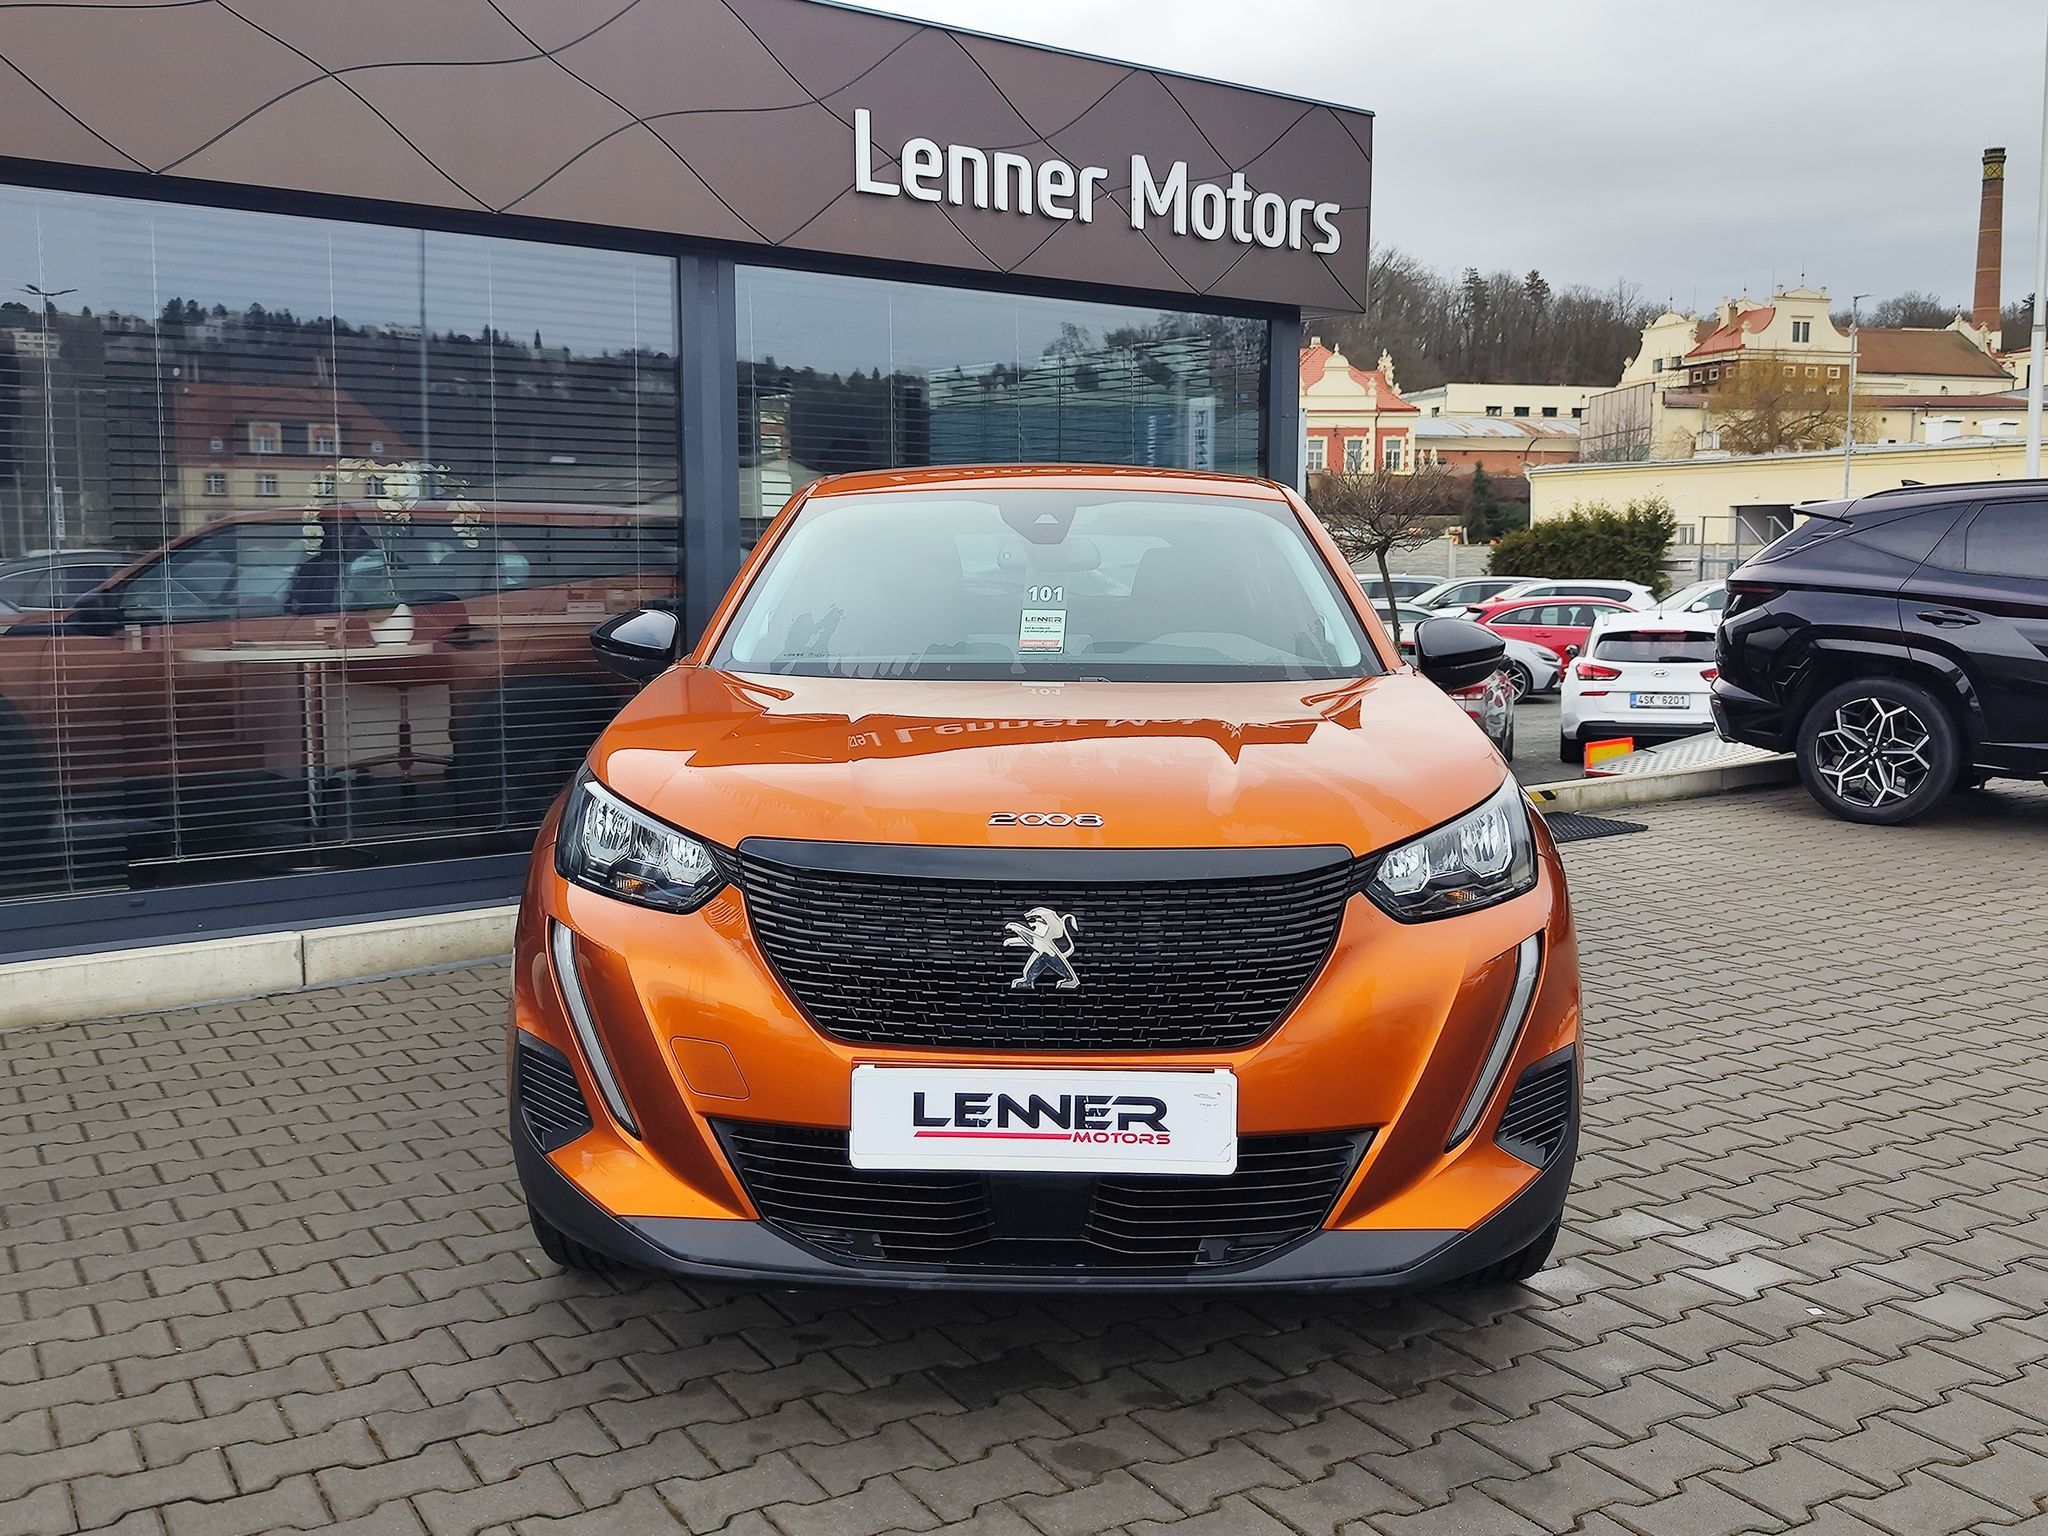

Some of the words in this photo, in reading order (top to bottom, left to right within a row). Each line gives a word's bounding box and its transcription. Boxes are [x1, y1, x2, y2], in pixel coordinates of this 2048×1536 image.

[854, 108, 1109, 224] Lenner
[1130, 153, 1341, 254] Motors
[1028, 586, 1063, 602] 101
[1638, 695, 1655, 705] 4SK
[1661, 695, 1685, 705] 6201
[987, 811, 1104, 828] 2008
[913, 1091, 1170, 1132] LENNER
[1072, 1131, 1170, 1145] MOTORS
